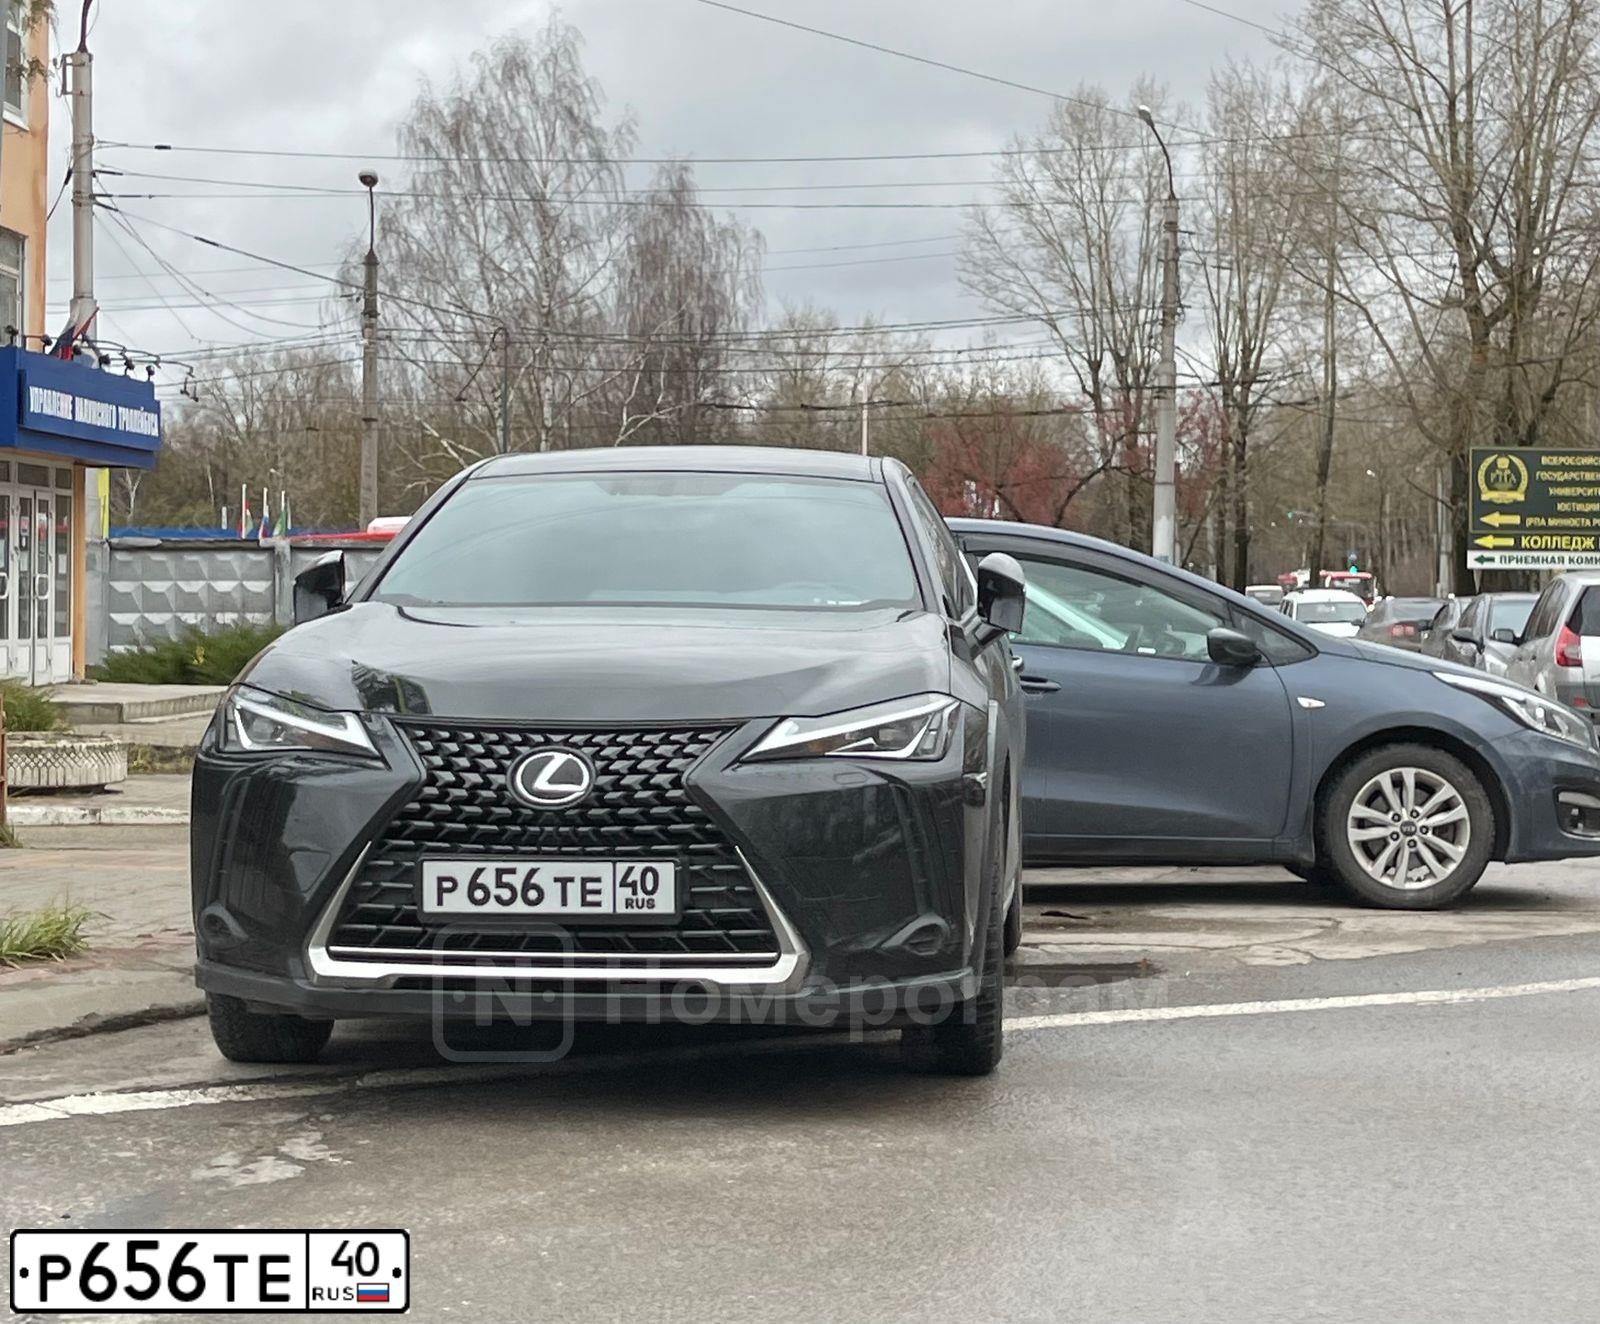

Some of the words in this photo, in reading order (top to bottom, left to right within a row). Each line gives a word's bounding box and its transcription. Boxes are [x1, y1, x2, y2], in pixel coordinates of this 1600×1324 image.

[1541, 455, 1600, 465] ВСЕРОССИЙС
[1549, 487, 1600, 496] УНИВЕРСИТ
[1521, 536, 1595, 551] КОЛЛЕДЖ
[1500, 556, 1565, 565] ПРИЕМНАЯ
[619, 866, 659, 896] 40
[625, 898, 656, 909] RUS
